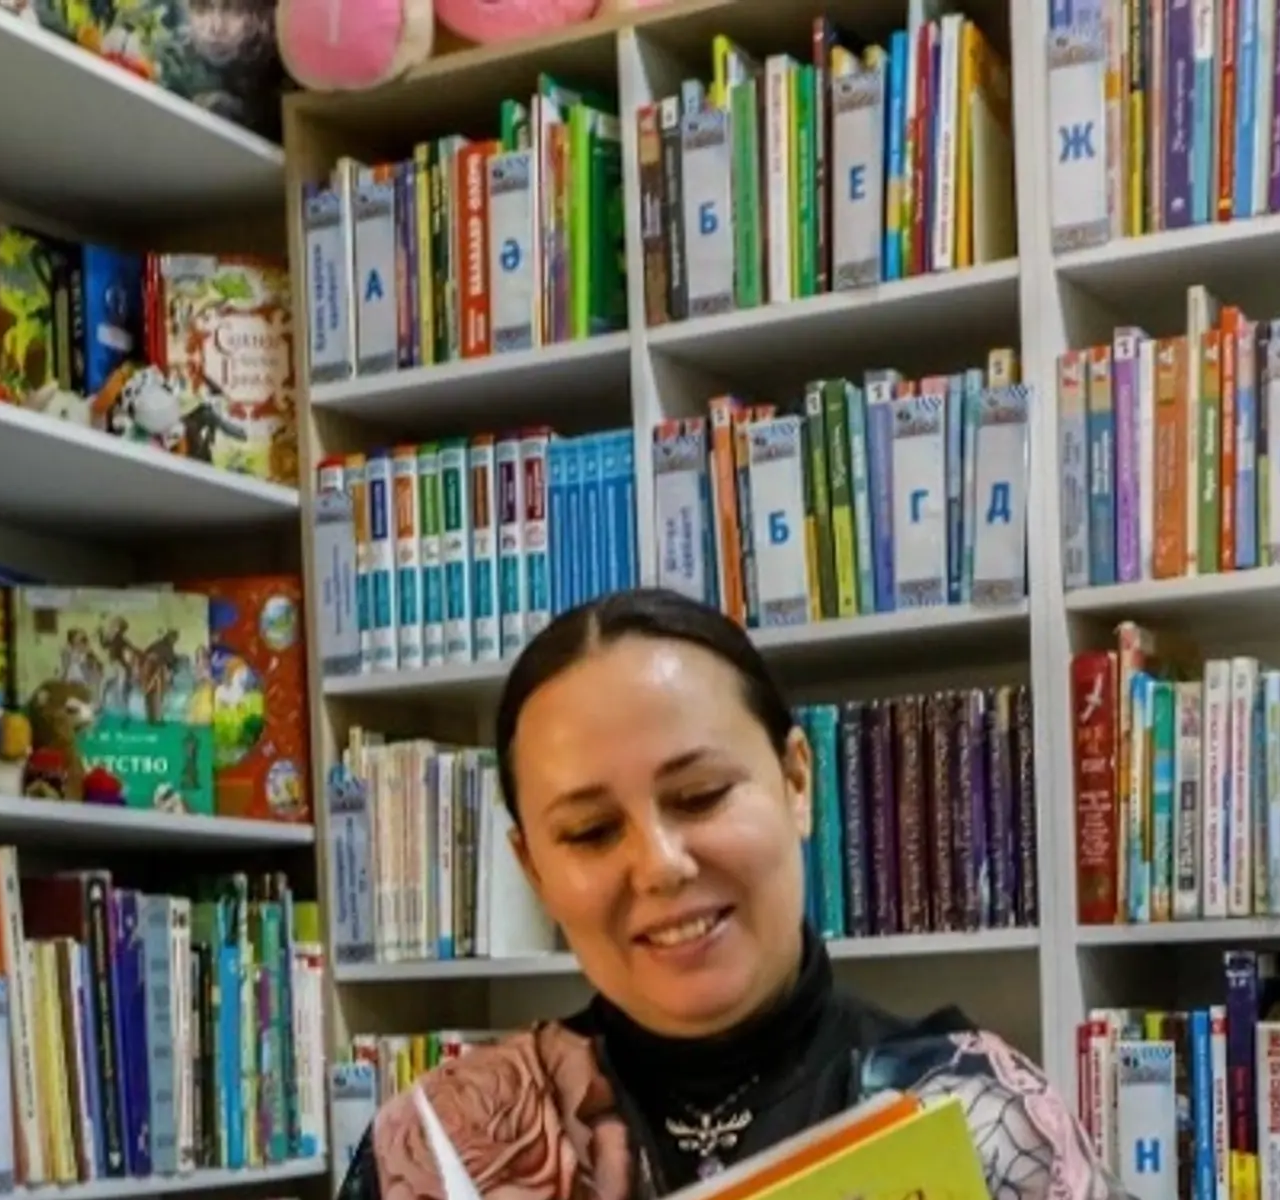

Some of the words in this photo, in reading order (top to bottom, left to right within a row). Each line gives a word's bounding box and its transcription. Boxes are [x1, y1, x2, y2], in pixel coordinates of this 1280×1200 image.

[1059, 124, 1096, 163] Ж
[848, 164, 867, 200] Е
[698, 203, 720, 235] Б
[501, 242, 522, 271] Ә
[365, 275, 385, 301] А
[910, 488, 929, 523] Г
[987, 481, 1013, 525] Д
[767, 512, 791, 545] Б
[1133, 1139, 1163, 1173] Н
